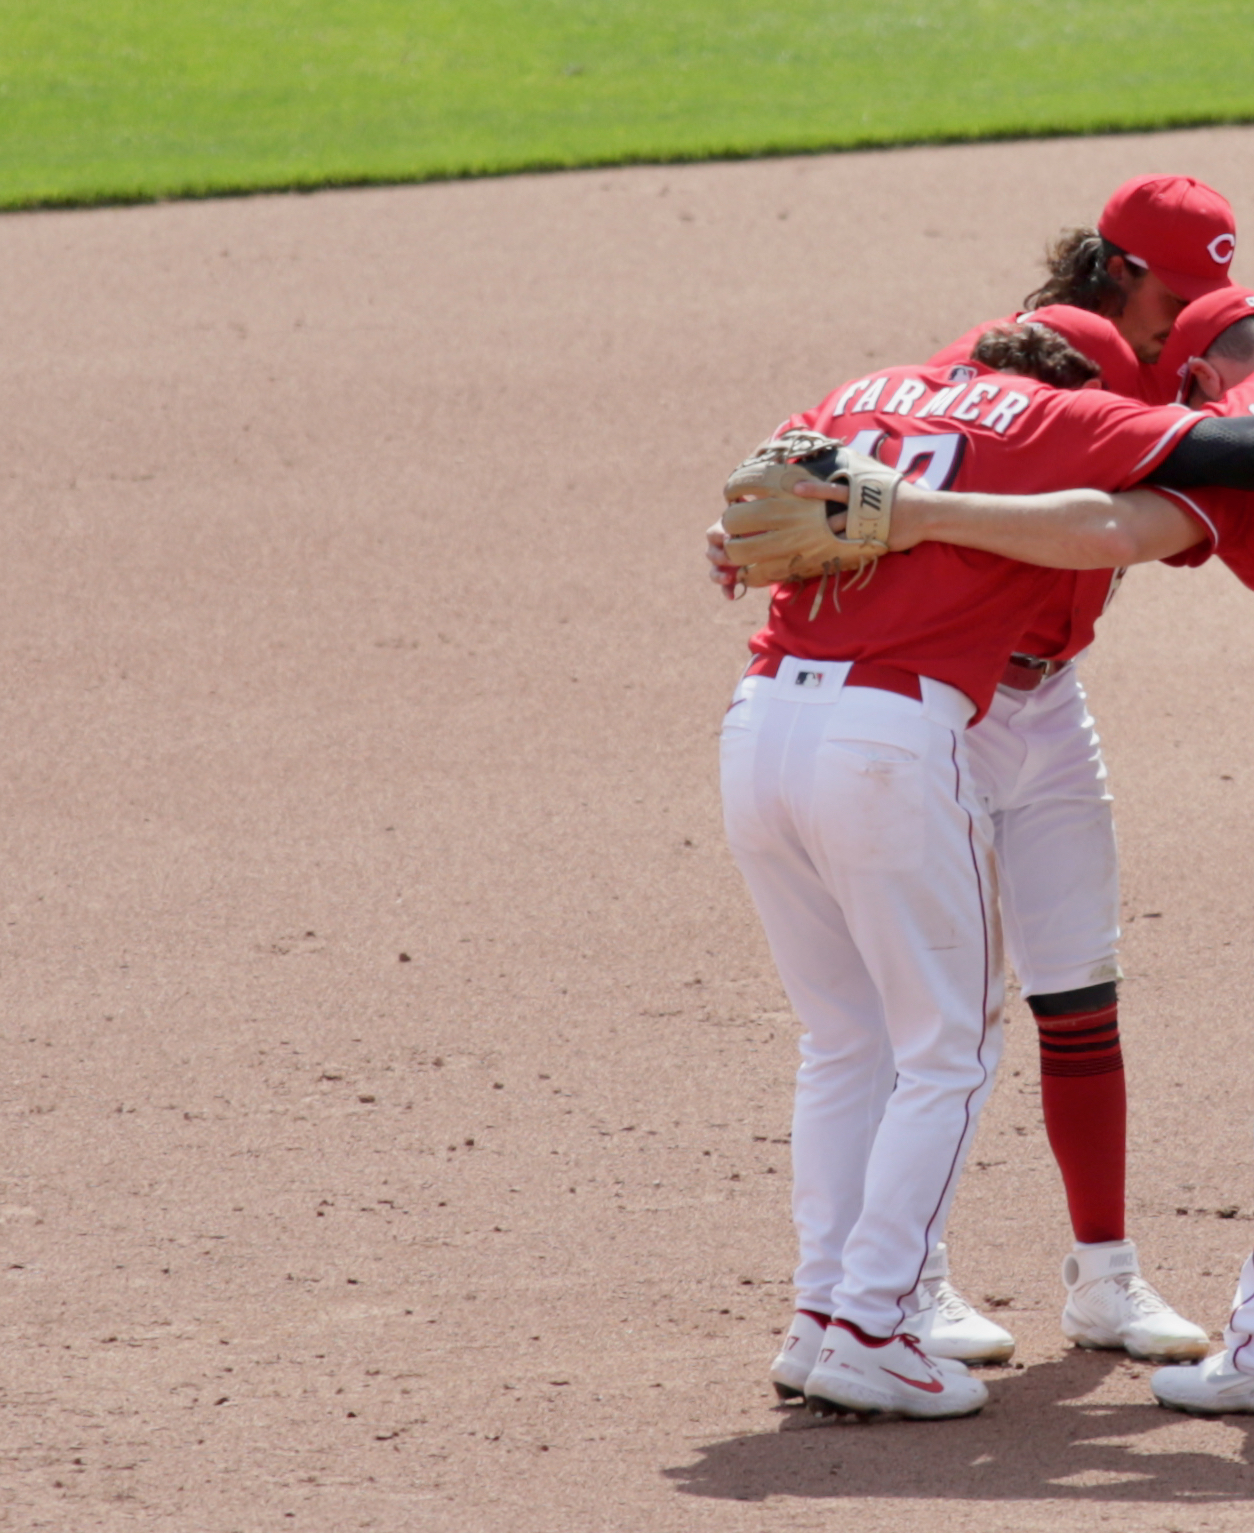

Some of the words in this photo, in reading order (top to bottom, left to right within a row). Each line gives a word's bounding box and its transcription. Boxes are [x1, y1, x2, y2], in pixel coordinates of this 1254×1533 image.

[1206, 233, 1235, 264] C
[833, 377, 1030, 435] FARMER
[819, 1348, 836, 1363] 17
